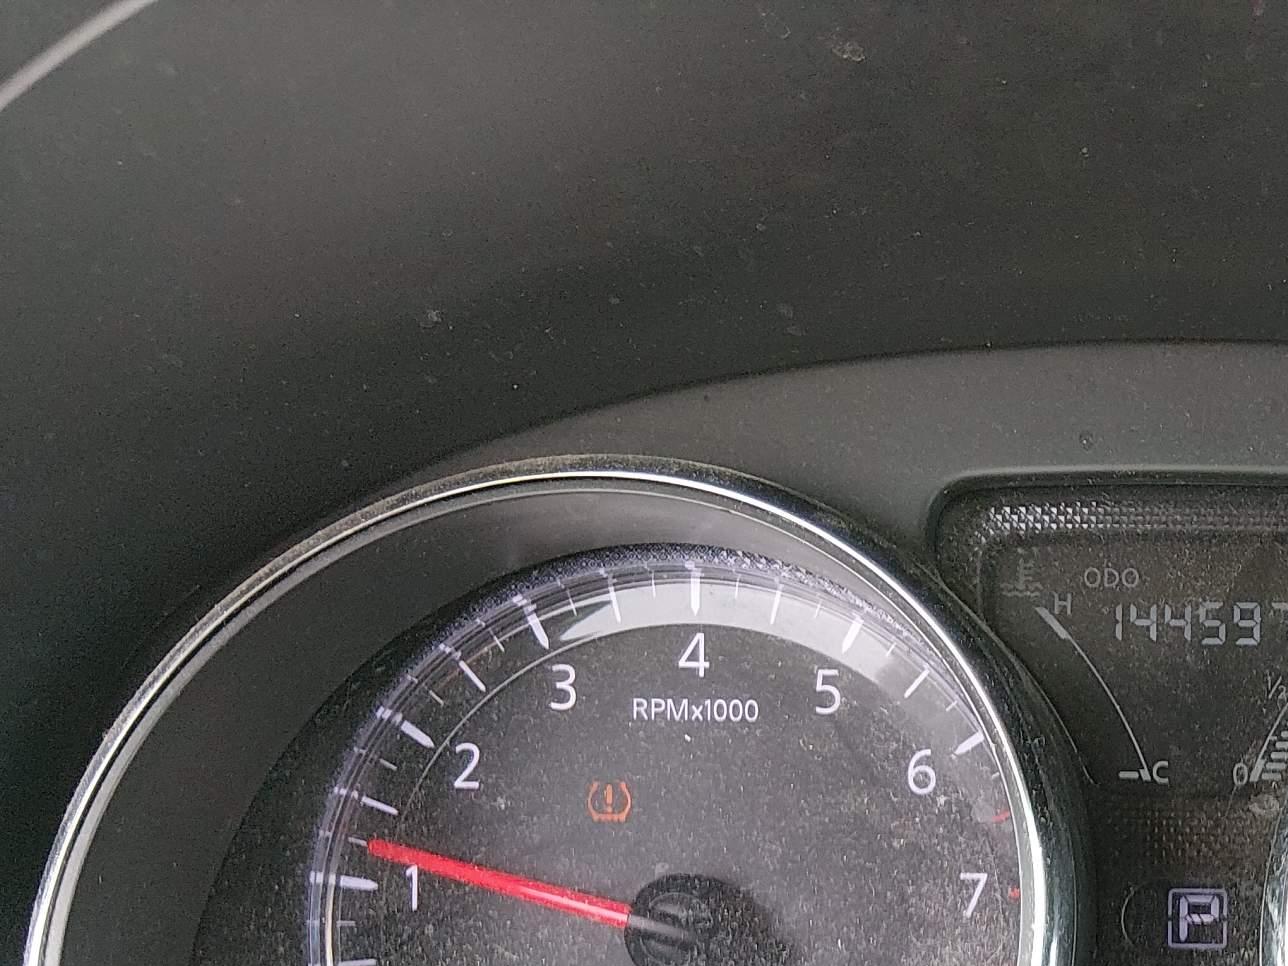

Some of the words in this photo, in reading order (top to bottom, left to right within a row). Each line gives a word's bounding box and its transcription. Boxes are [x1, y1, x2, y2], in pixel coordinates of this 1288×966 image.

[1083, 567, 1140, 589] ODO
[1053, 594, 1073, 615] H
[678, 632, 710, 677] 4
[550, 664, 577, 710] 3
[813, 668, 842, 714] 5
[631, 697, 760, 723] RPMx1000
[453, 743, 481, 791] 2
[907, 748, 936, 795] 6
[1152, 760, 1170, 785] C
[1232, 762, 1248, 786] 0
[405, 865, 420, 911] 1
[960, 873, 988, 918] 7
[1178, 894, 1220, 942] P
